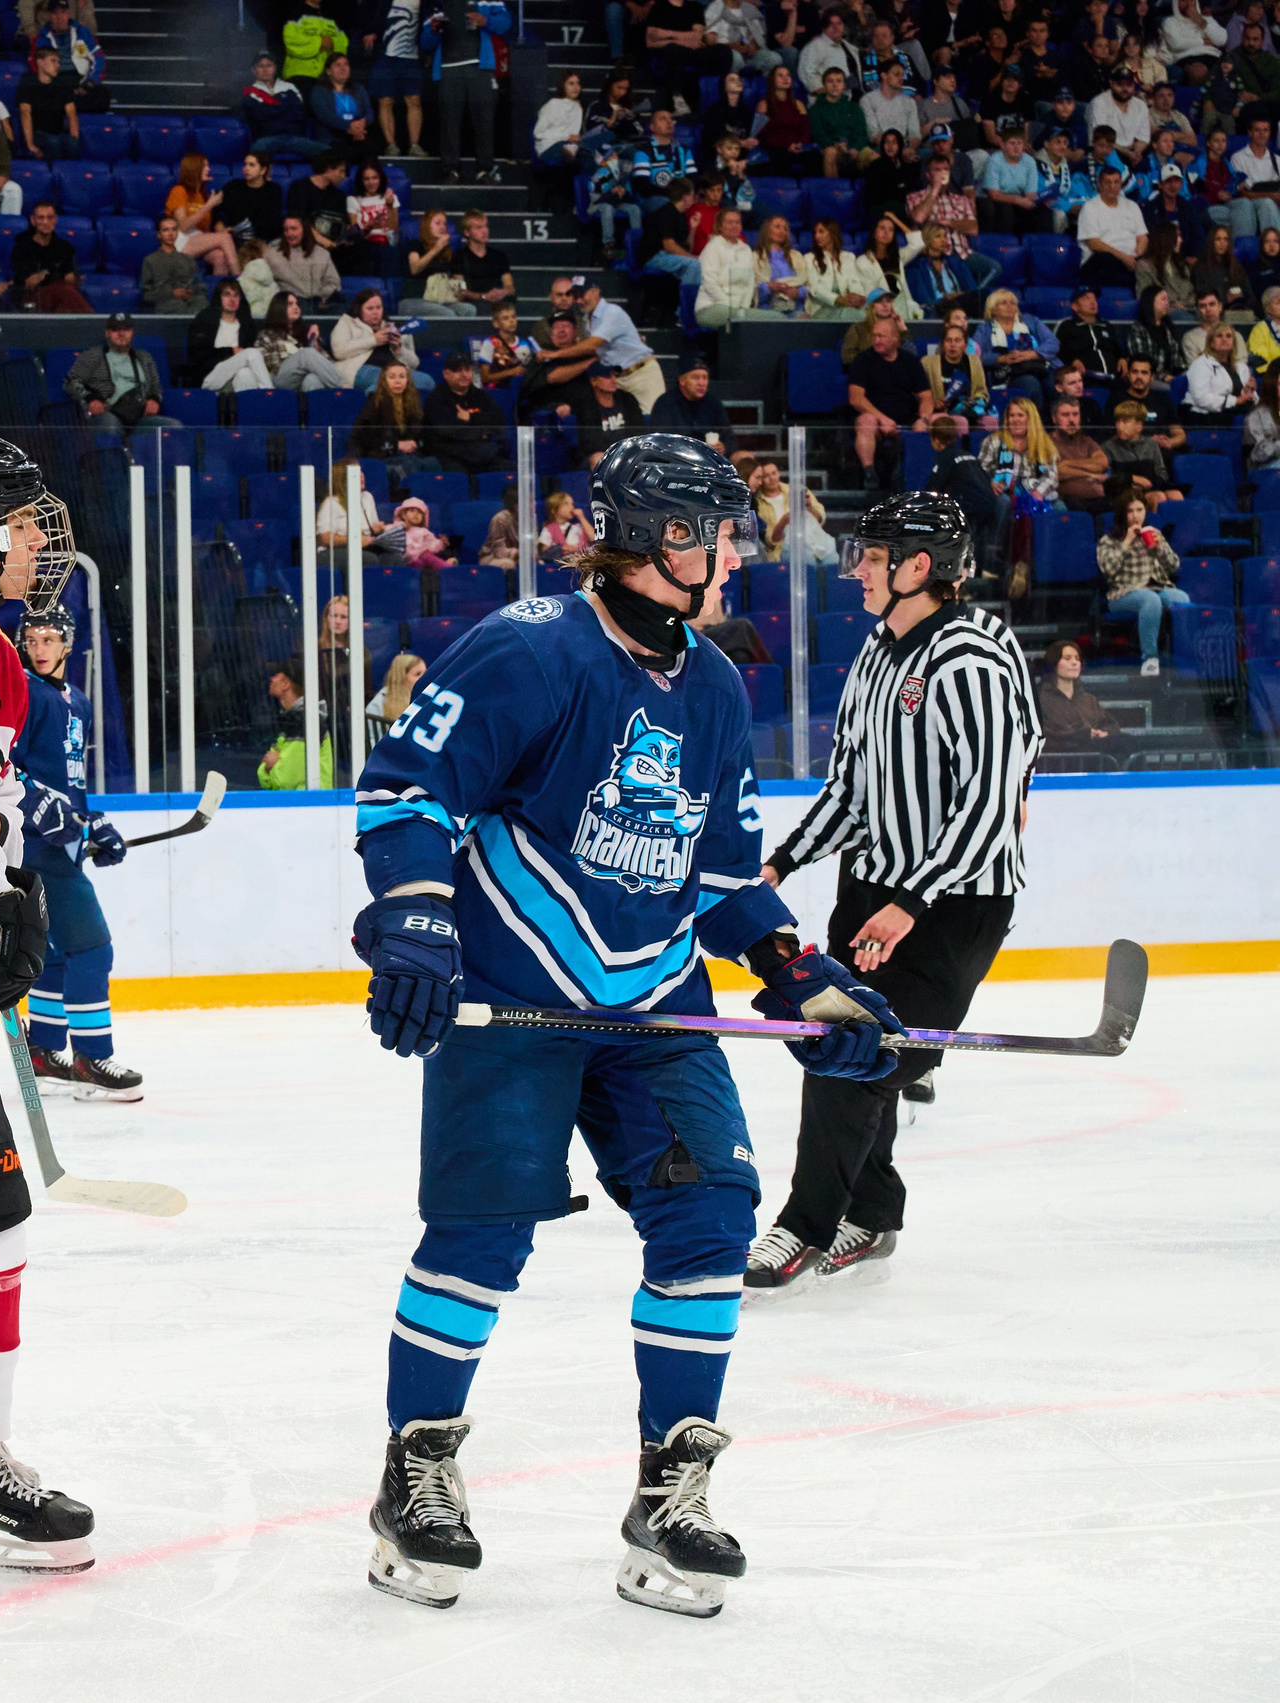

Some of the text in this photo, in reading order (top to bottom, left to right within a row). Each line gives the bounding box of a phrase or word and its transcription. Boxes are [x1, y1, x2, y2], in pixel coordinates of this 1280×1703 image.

[560, 26, 585, 44] 17
[522, 219, 549, 241] 13
[388, 682, 465, 753] 53
